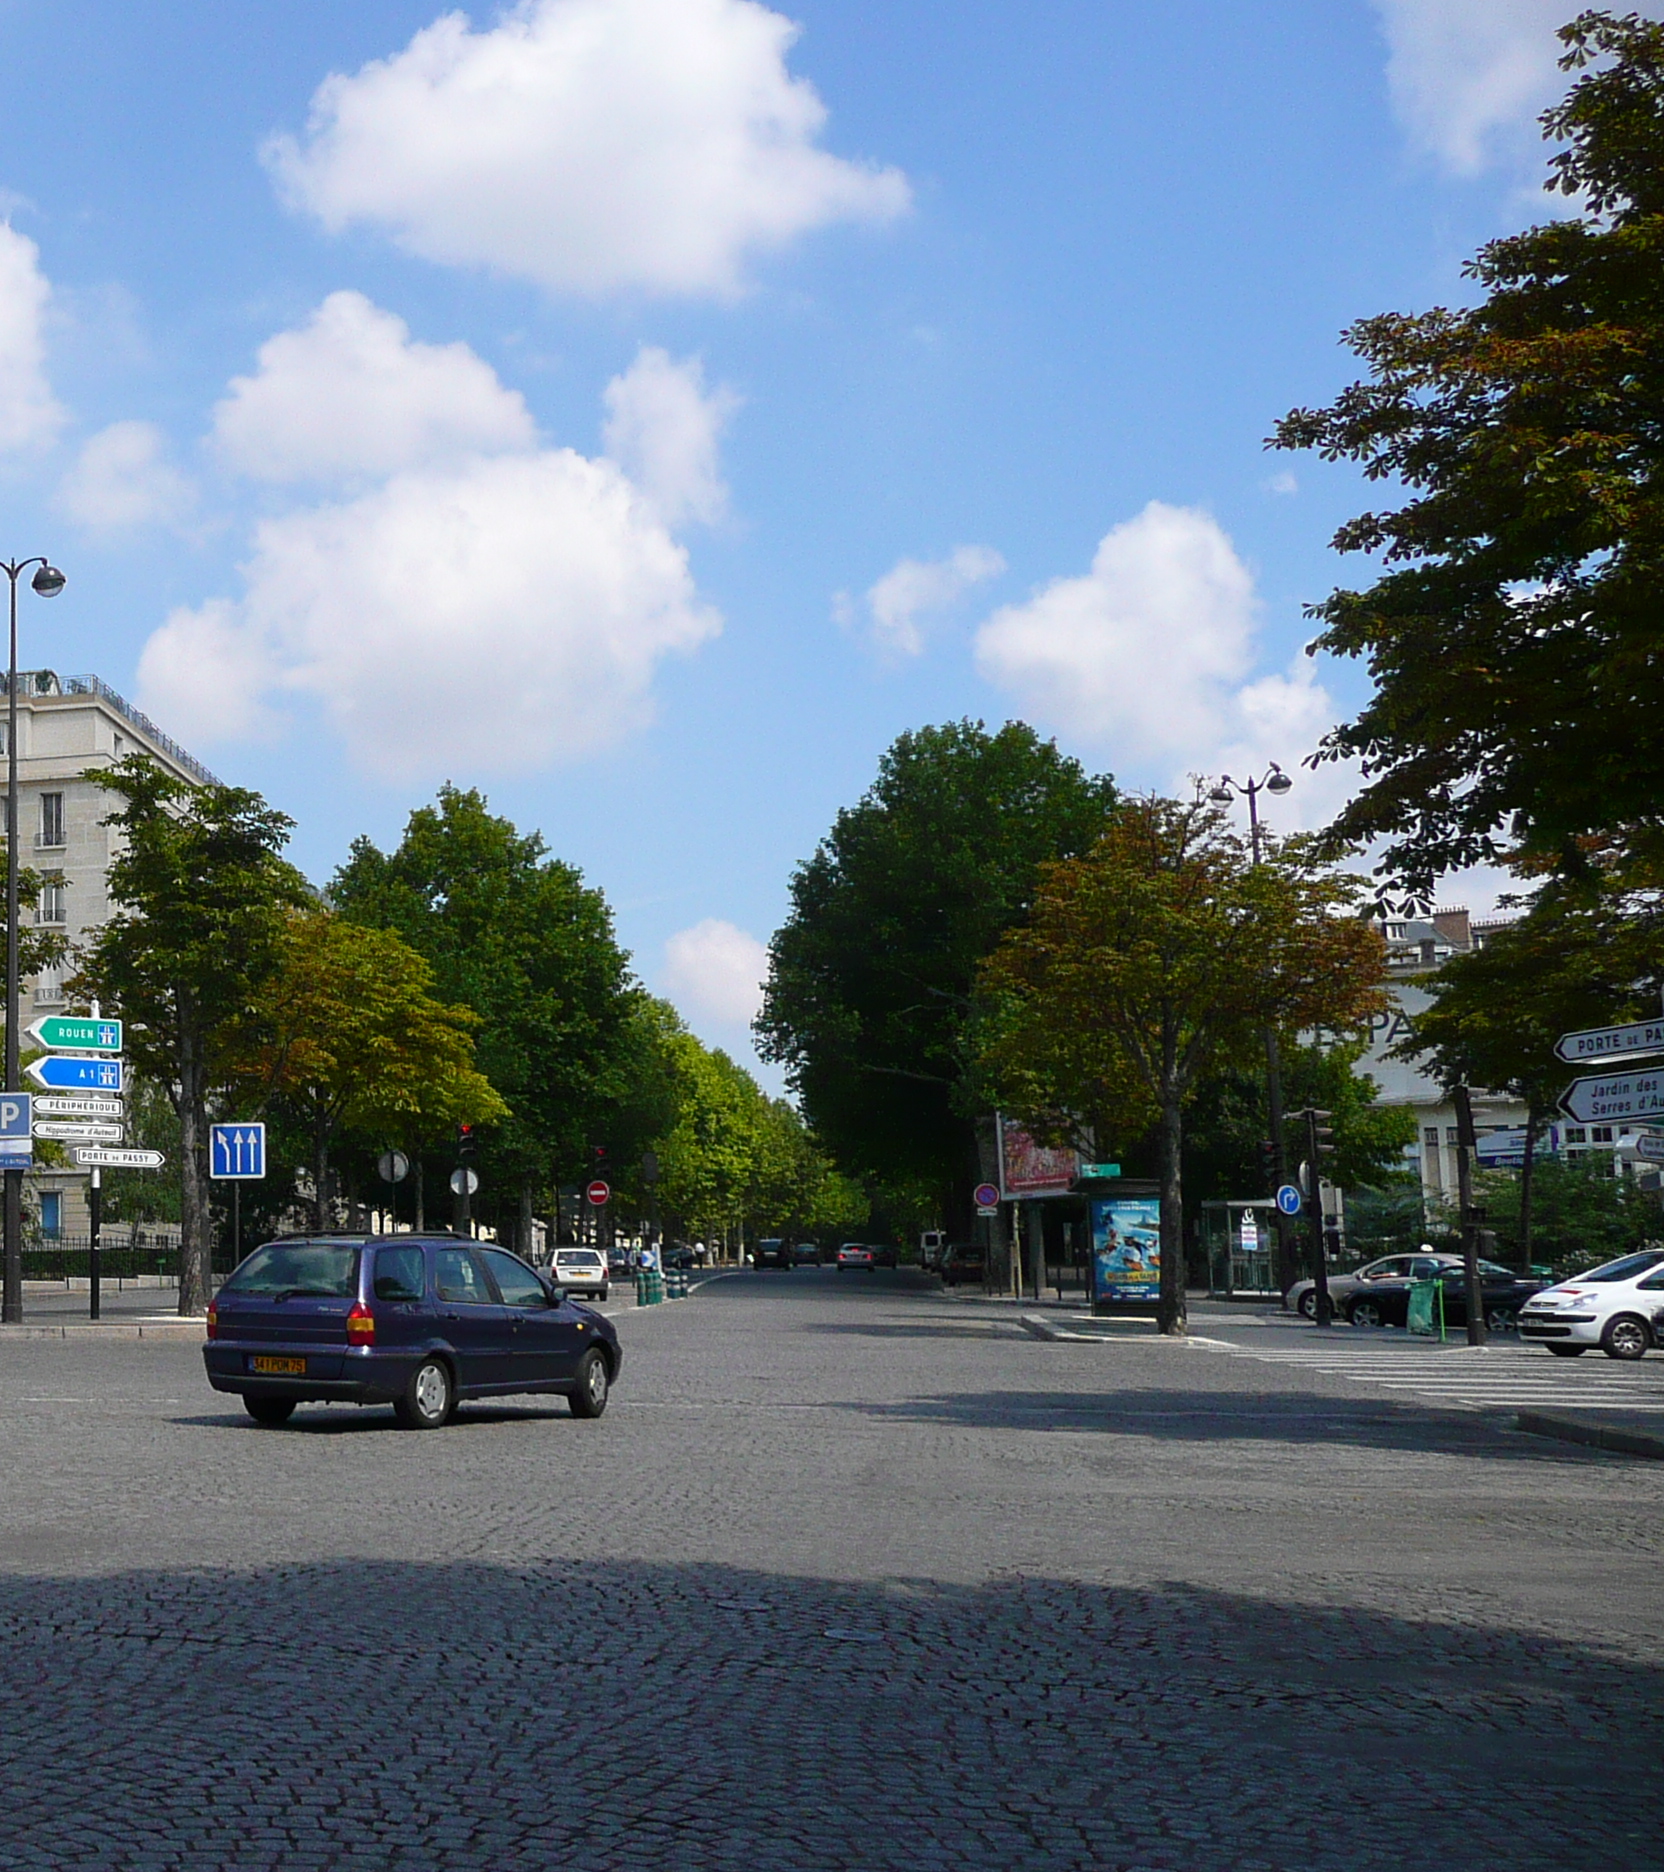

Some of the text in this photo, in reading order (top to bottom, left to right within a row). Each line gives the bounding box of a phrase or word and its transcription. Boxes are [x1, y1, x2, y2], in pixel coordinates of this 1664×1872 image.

[58, 1027, 94, 1039] ROUEN
[1578, 1034, 1621, 1052] PORTE
[79, 1068, 85, 1079] A
[1591, 1079, 1658, 1098] Jardin des
[1591, 1101, 1631, 1115] Serres
[0, 1101, 20, 1130] P
[45, 1126, 85, 1137] Hippodrome
[82, 1151, 108, 1161] PORTE
[122, 1153, 149, 1163] PASSY
